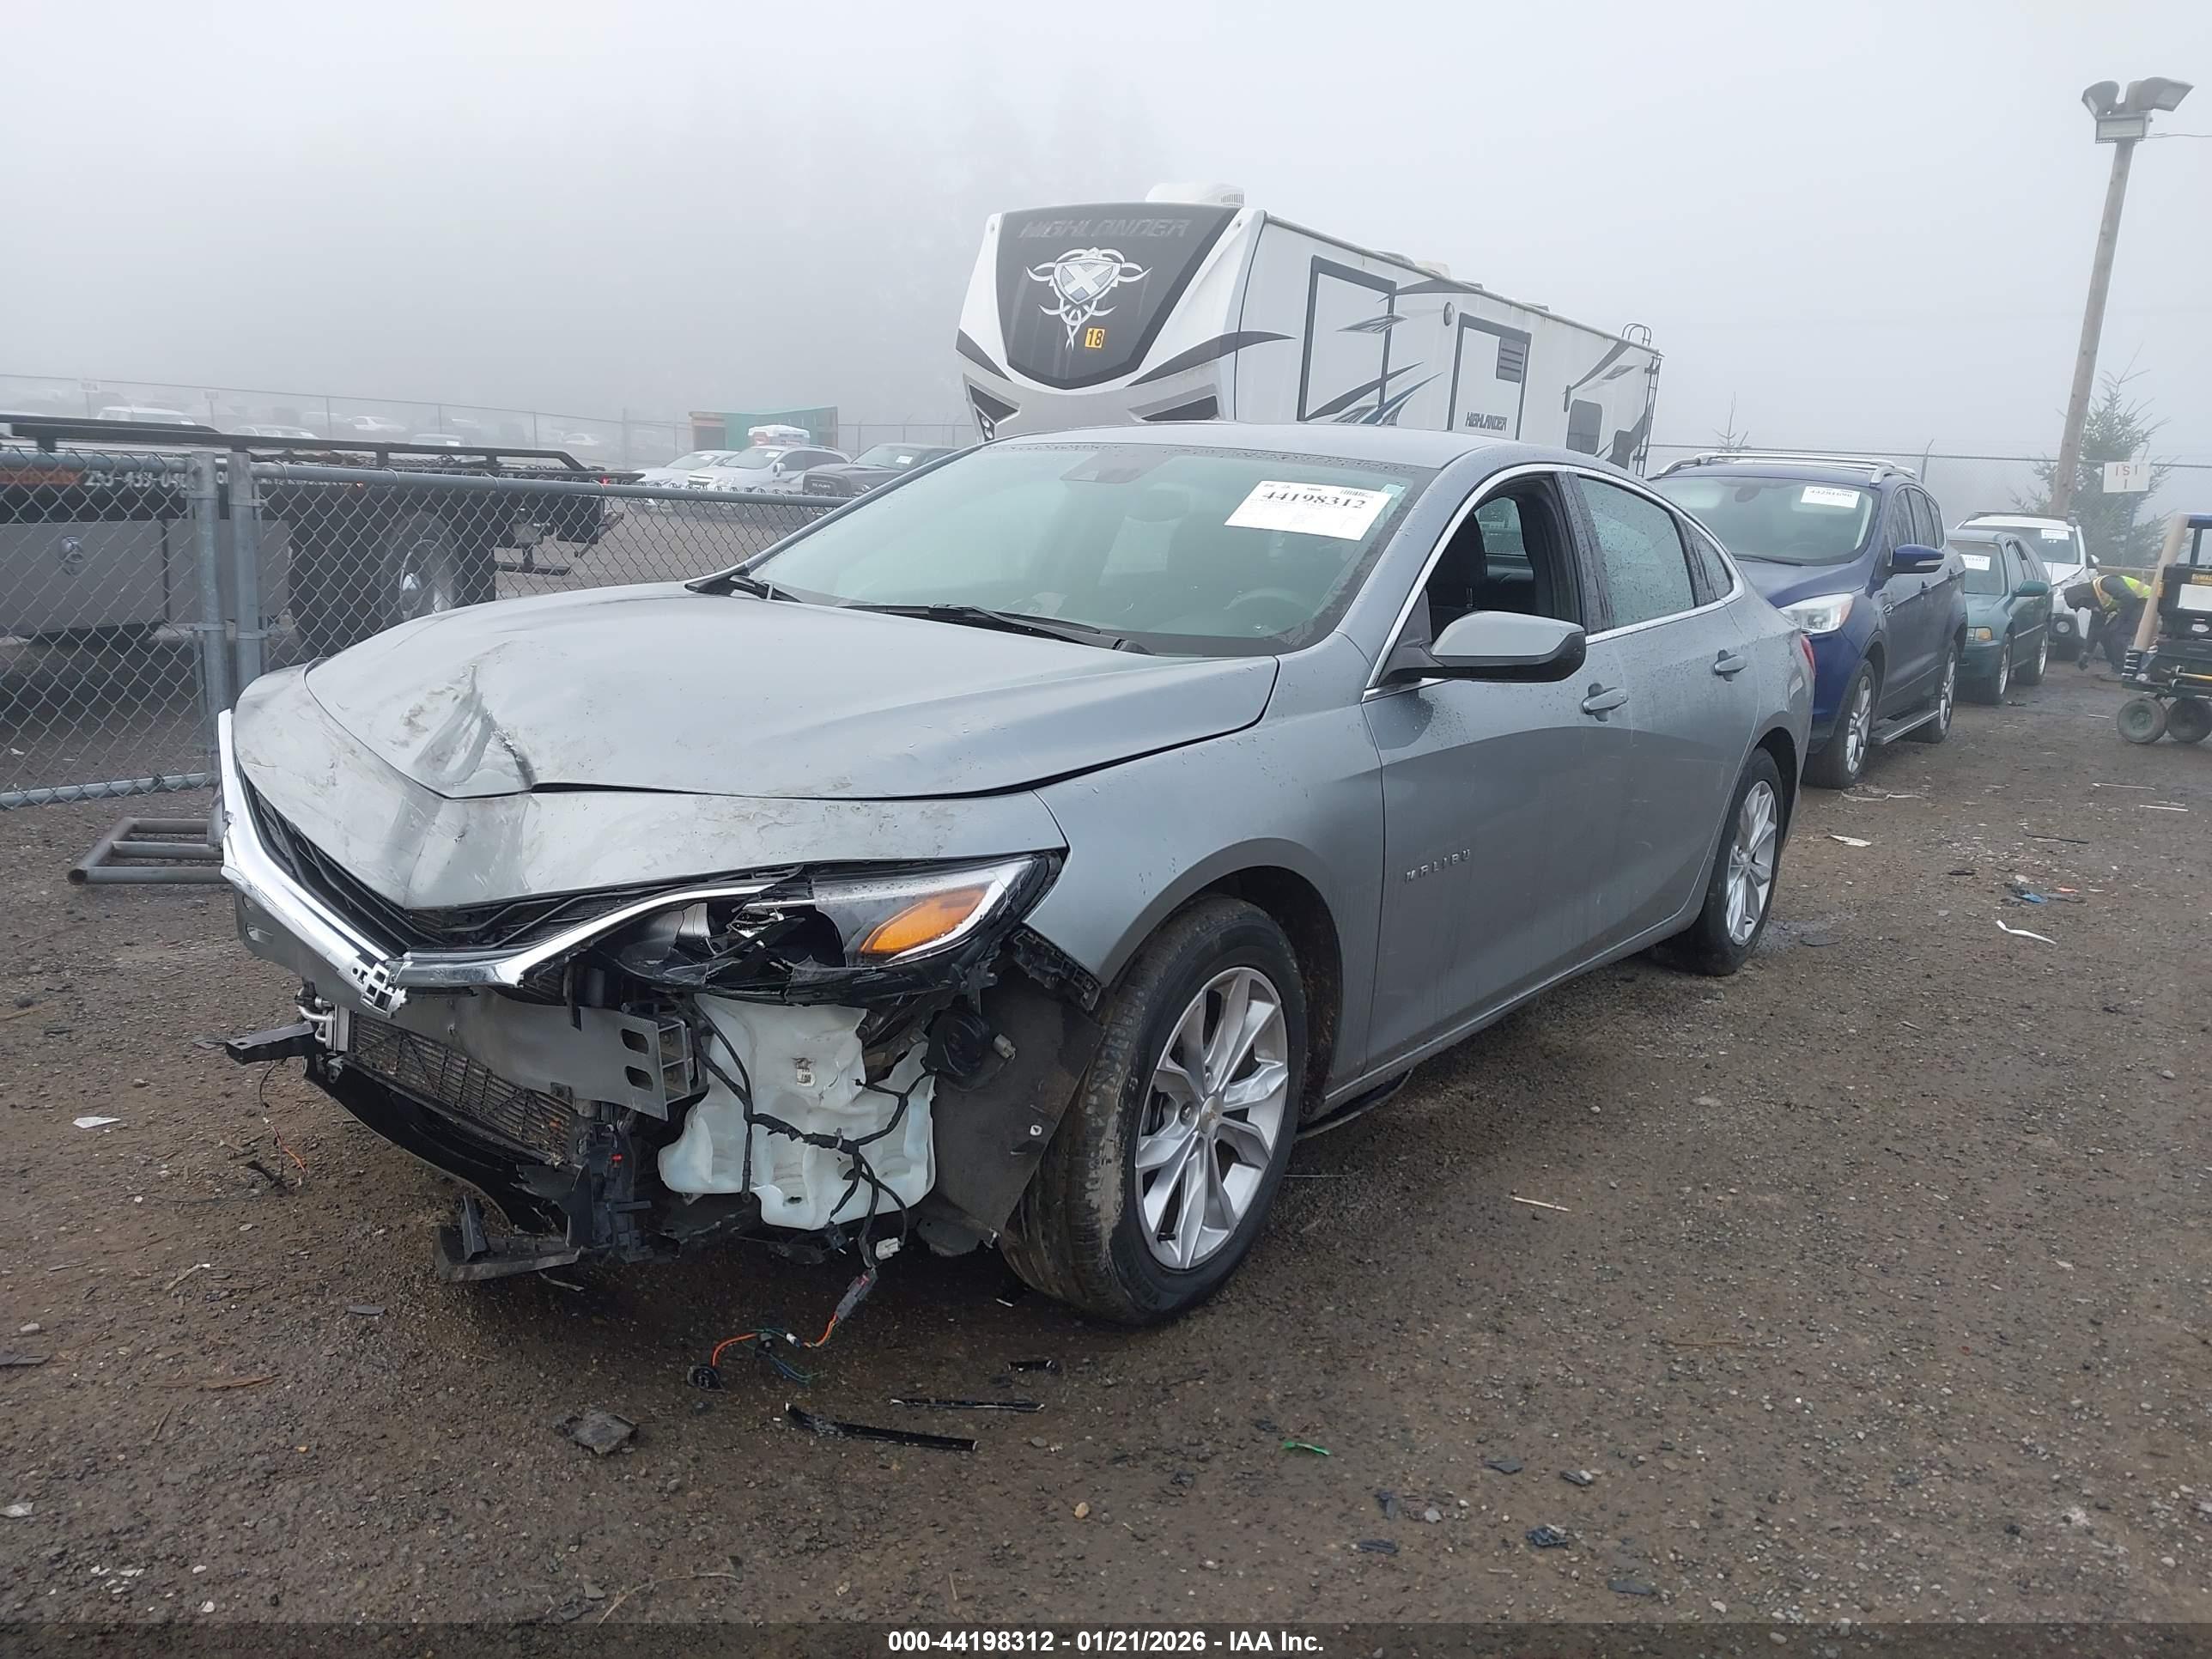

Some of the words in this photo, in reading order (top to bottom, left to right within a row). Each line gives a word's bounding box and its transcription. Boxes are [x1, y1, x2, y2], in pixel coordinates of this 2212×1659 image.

[1017, 219, 1193, 239] HIGHLANDER
[1088, 329, 1103, 347] 18
[1465, 412, 1508, 431] HIGHLANDER
[1262, 491, 1366, 508] 44198312
